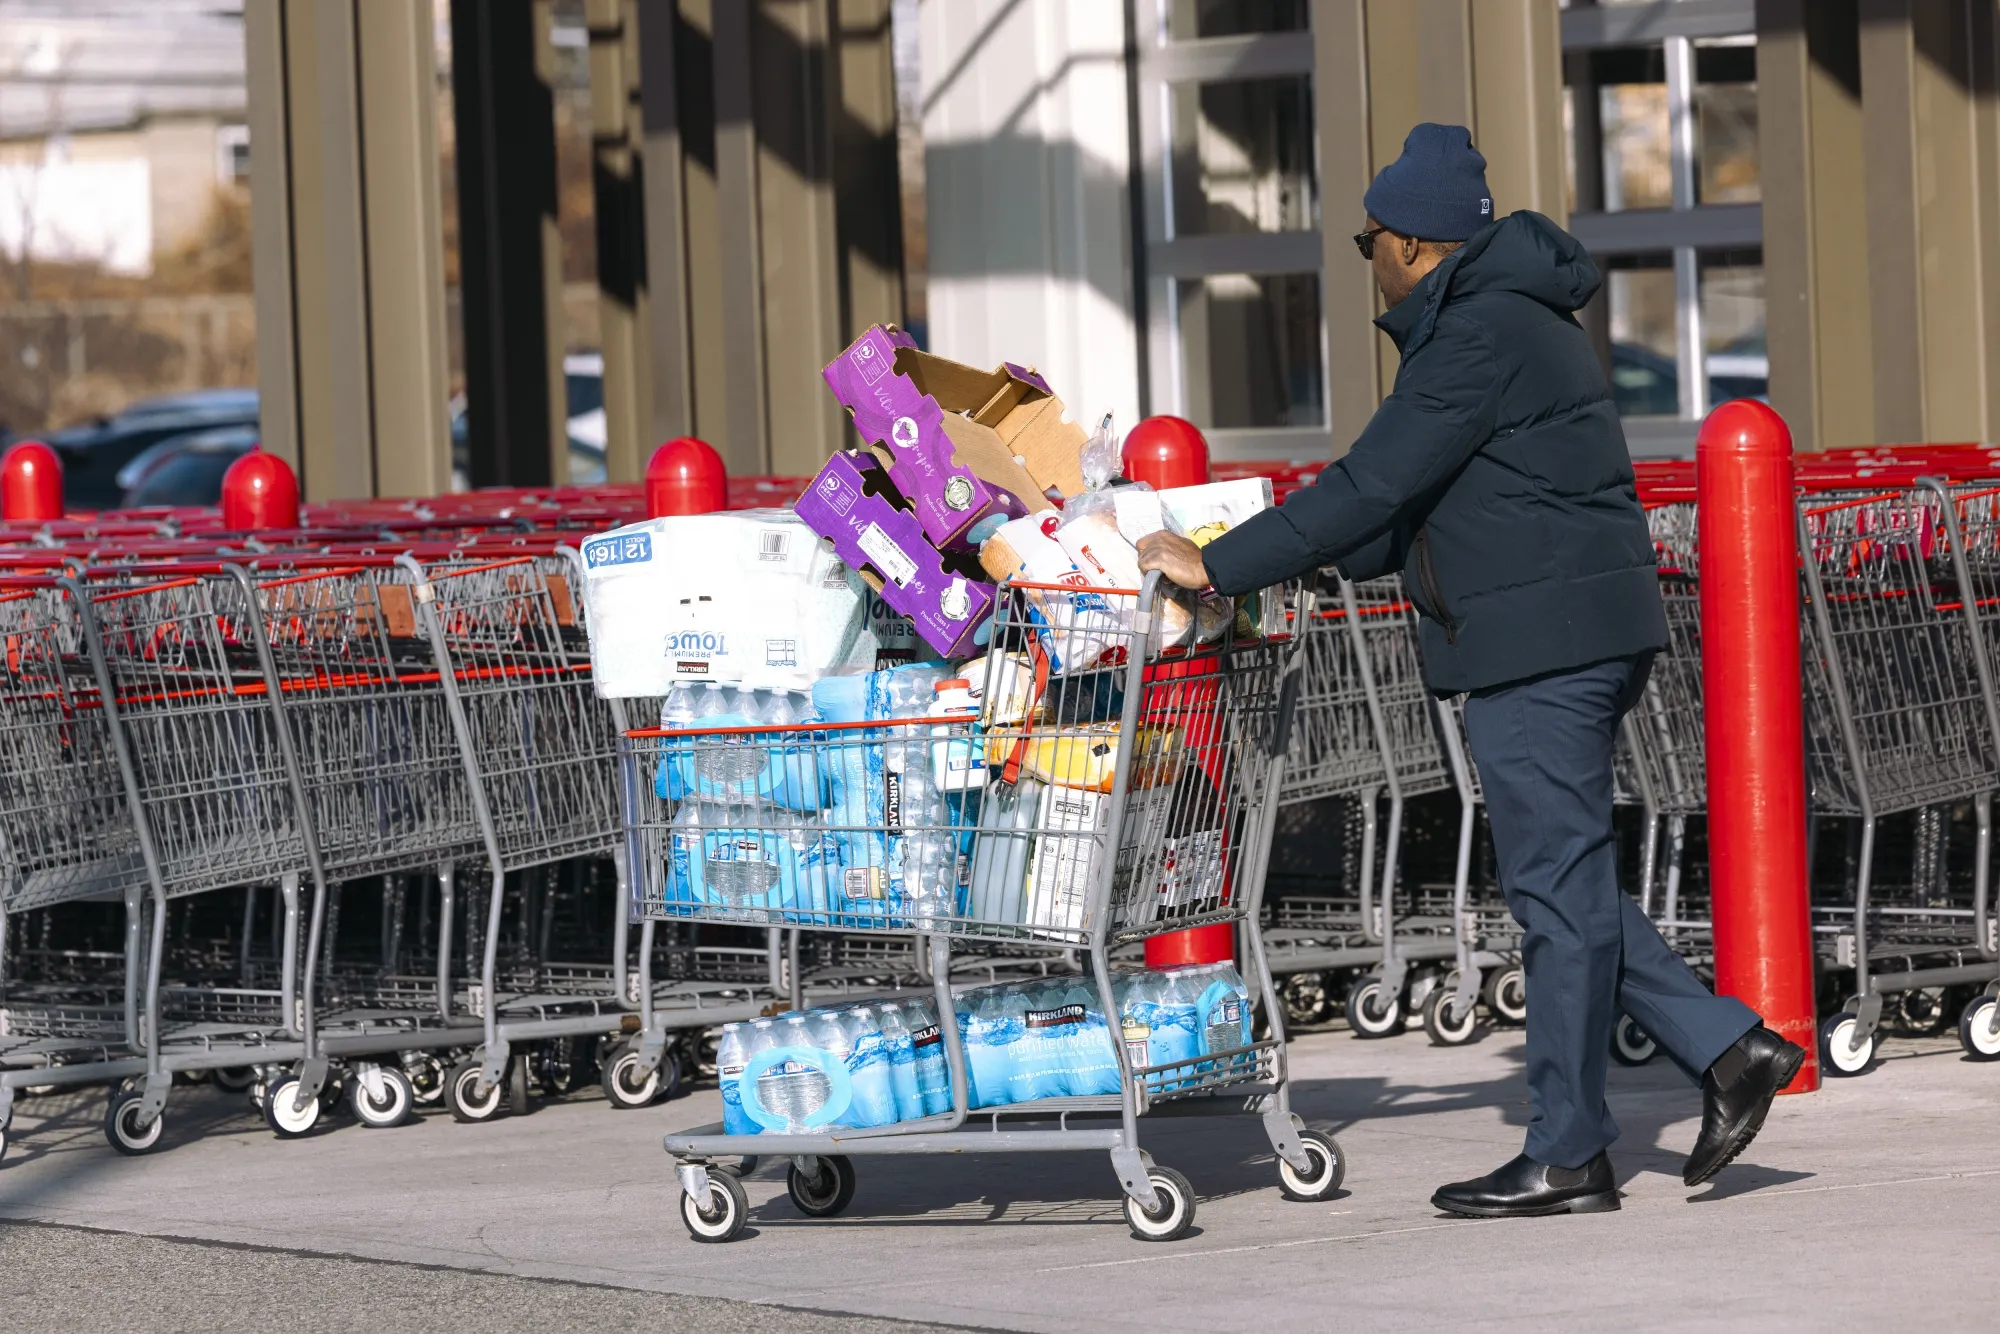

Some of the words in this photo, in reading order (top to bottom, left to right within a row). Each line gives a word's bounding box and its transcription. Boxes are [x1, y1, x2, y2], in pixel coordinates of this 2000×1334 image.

[821, 485, 835, 499] PEFC
[589, 545, 618, 563] 160
[626, 542, 647, 559] 12
[933, 612, 947, 627] Class
[666, 632, 729, 656] Towe
[677, 665, 708, 673] KIRKLAND
[888, 776, 900, 835] KIRKLAN
[1056, 804, 1089, 817] KRKLAND
[1028, 1005, 1084, 1022] KIRKLAND
[1007, 1034, 1065, 1059] purified
